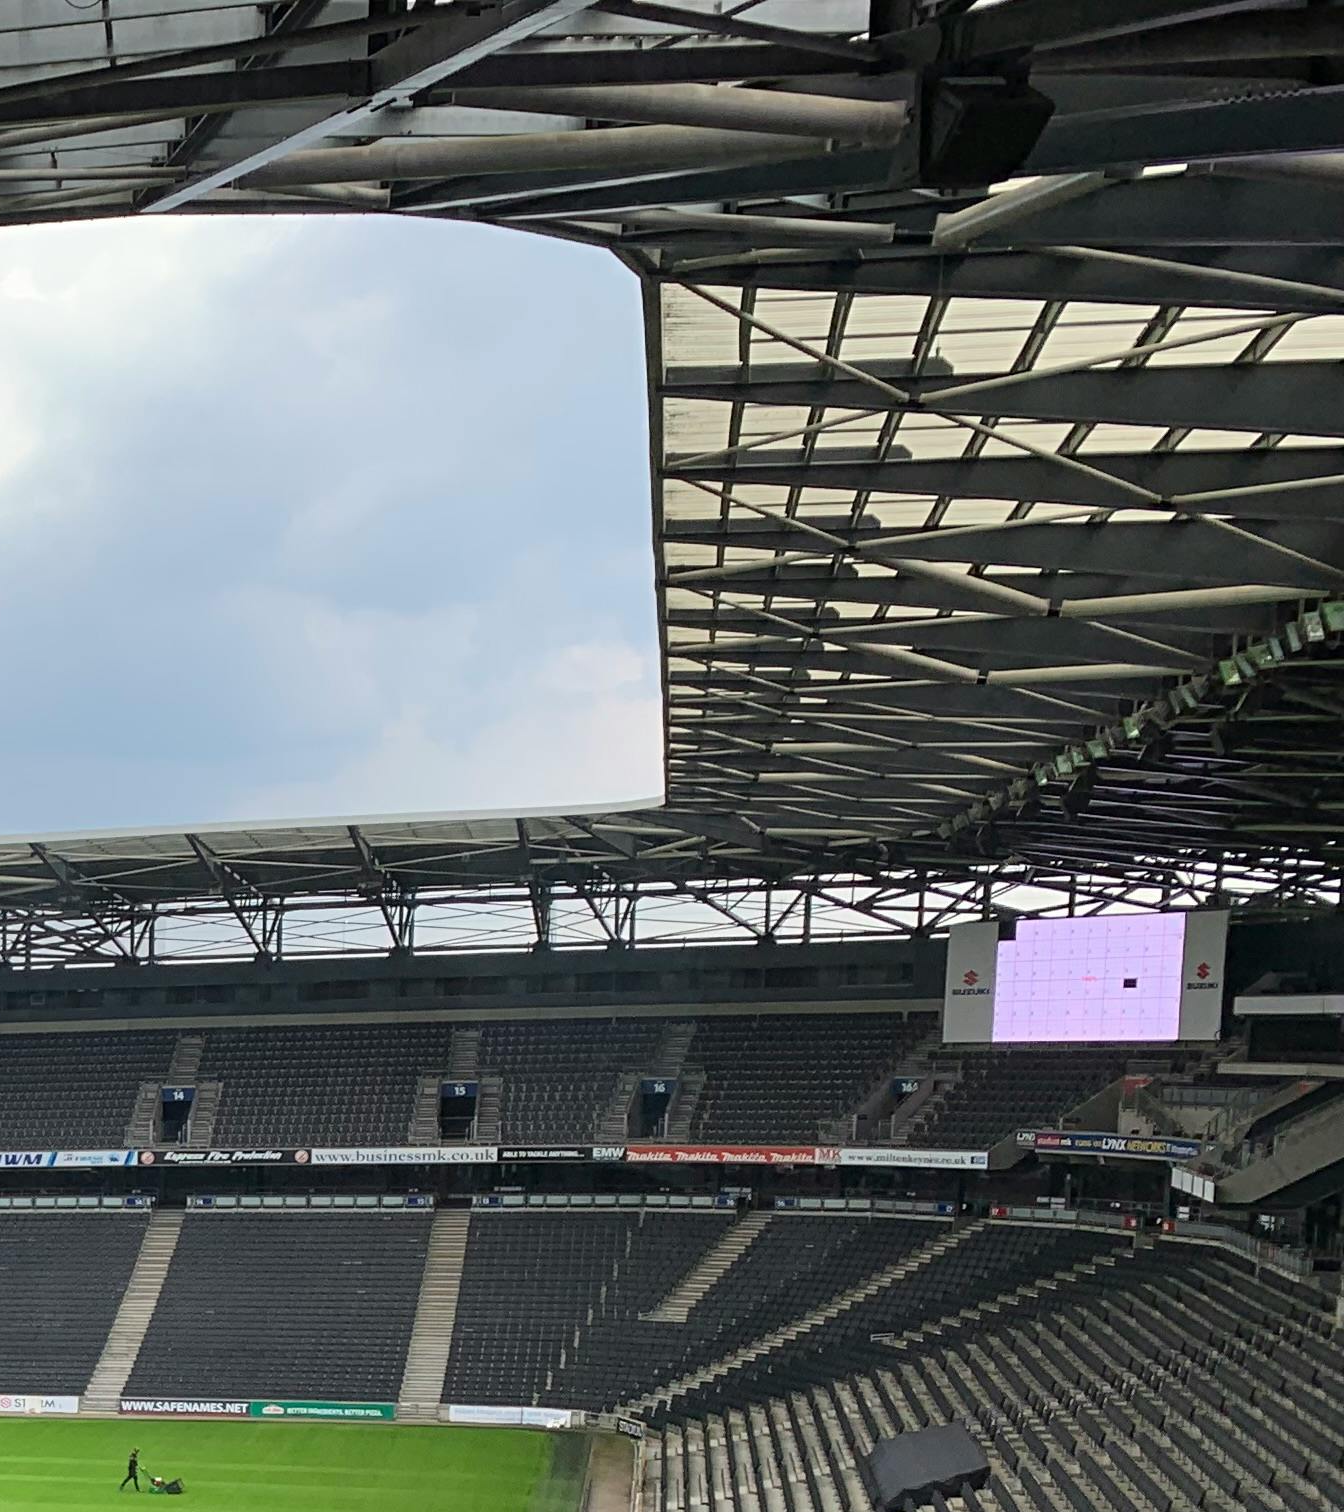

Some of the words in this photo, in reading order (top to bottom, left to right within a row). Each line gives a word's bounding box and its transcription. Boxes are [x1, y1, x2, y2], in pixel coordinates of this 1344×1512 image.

[1102, 1138, 1127, 1150] LYNX
[315, 1149, 494, 1163] www.businessmk.co.uk
[593, 1147, 625, 1157] EMW
[818, 1149, 841, 1159] MK
[121, 1400, 248, 1413] WWW.SAFENAMES.NET
